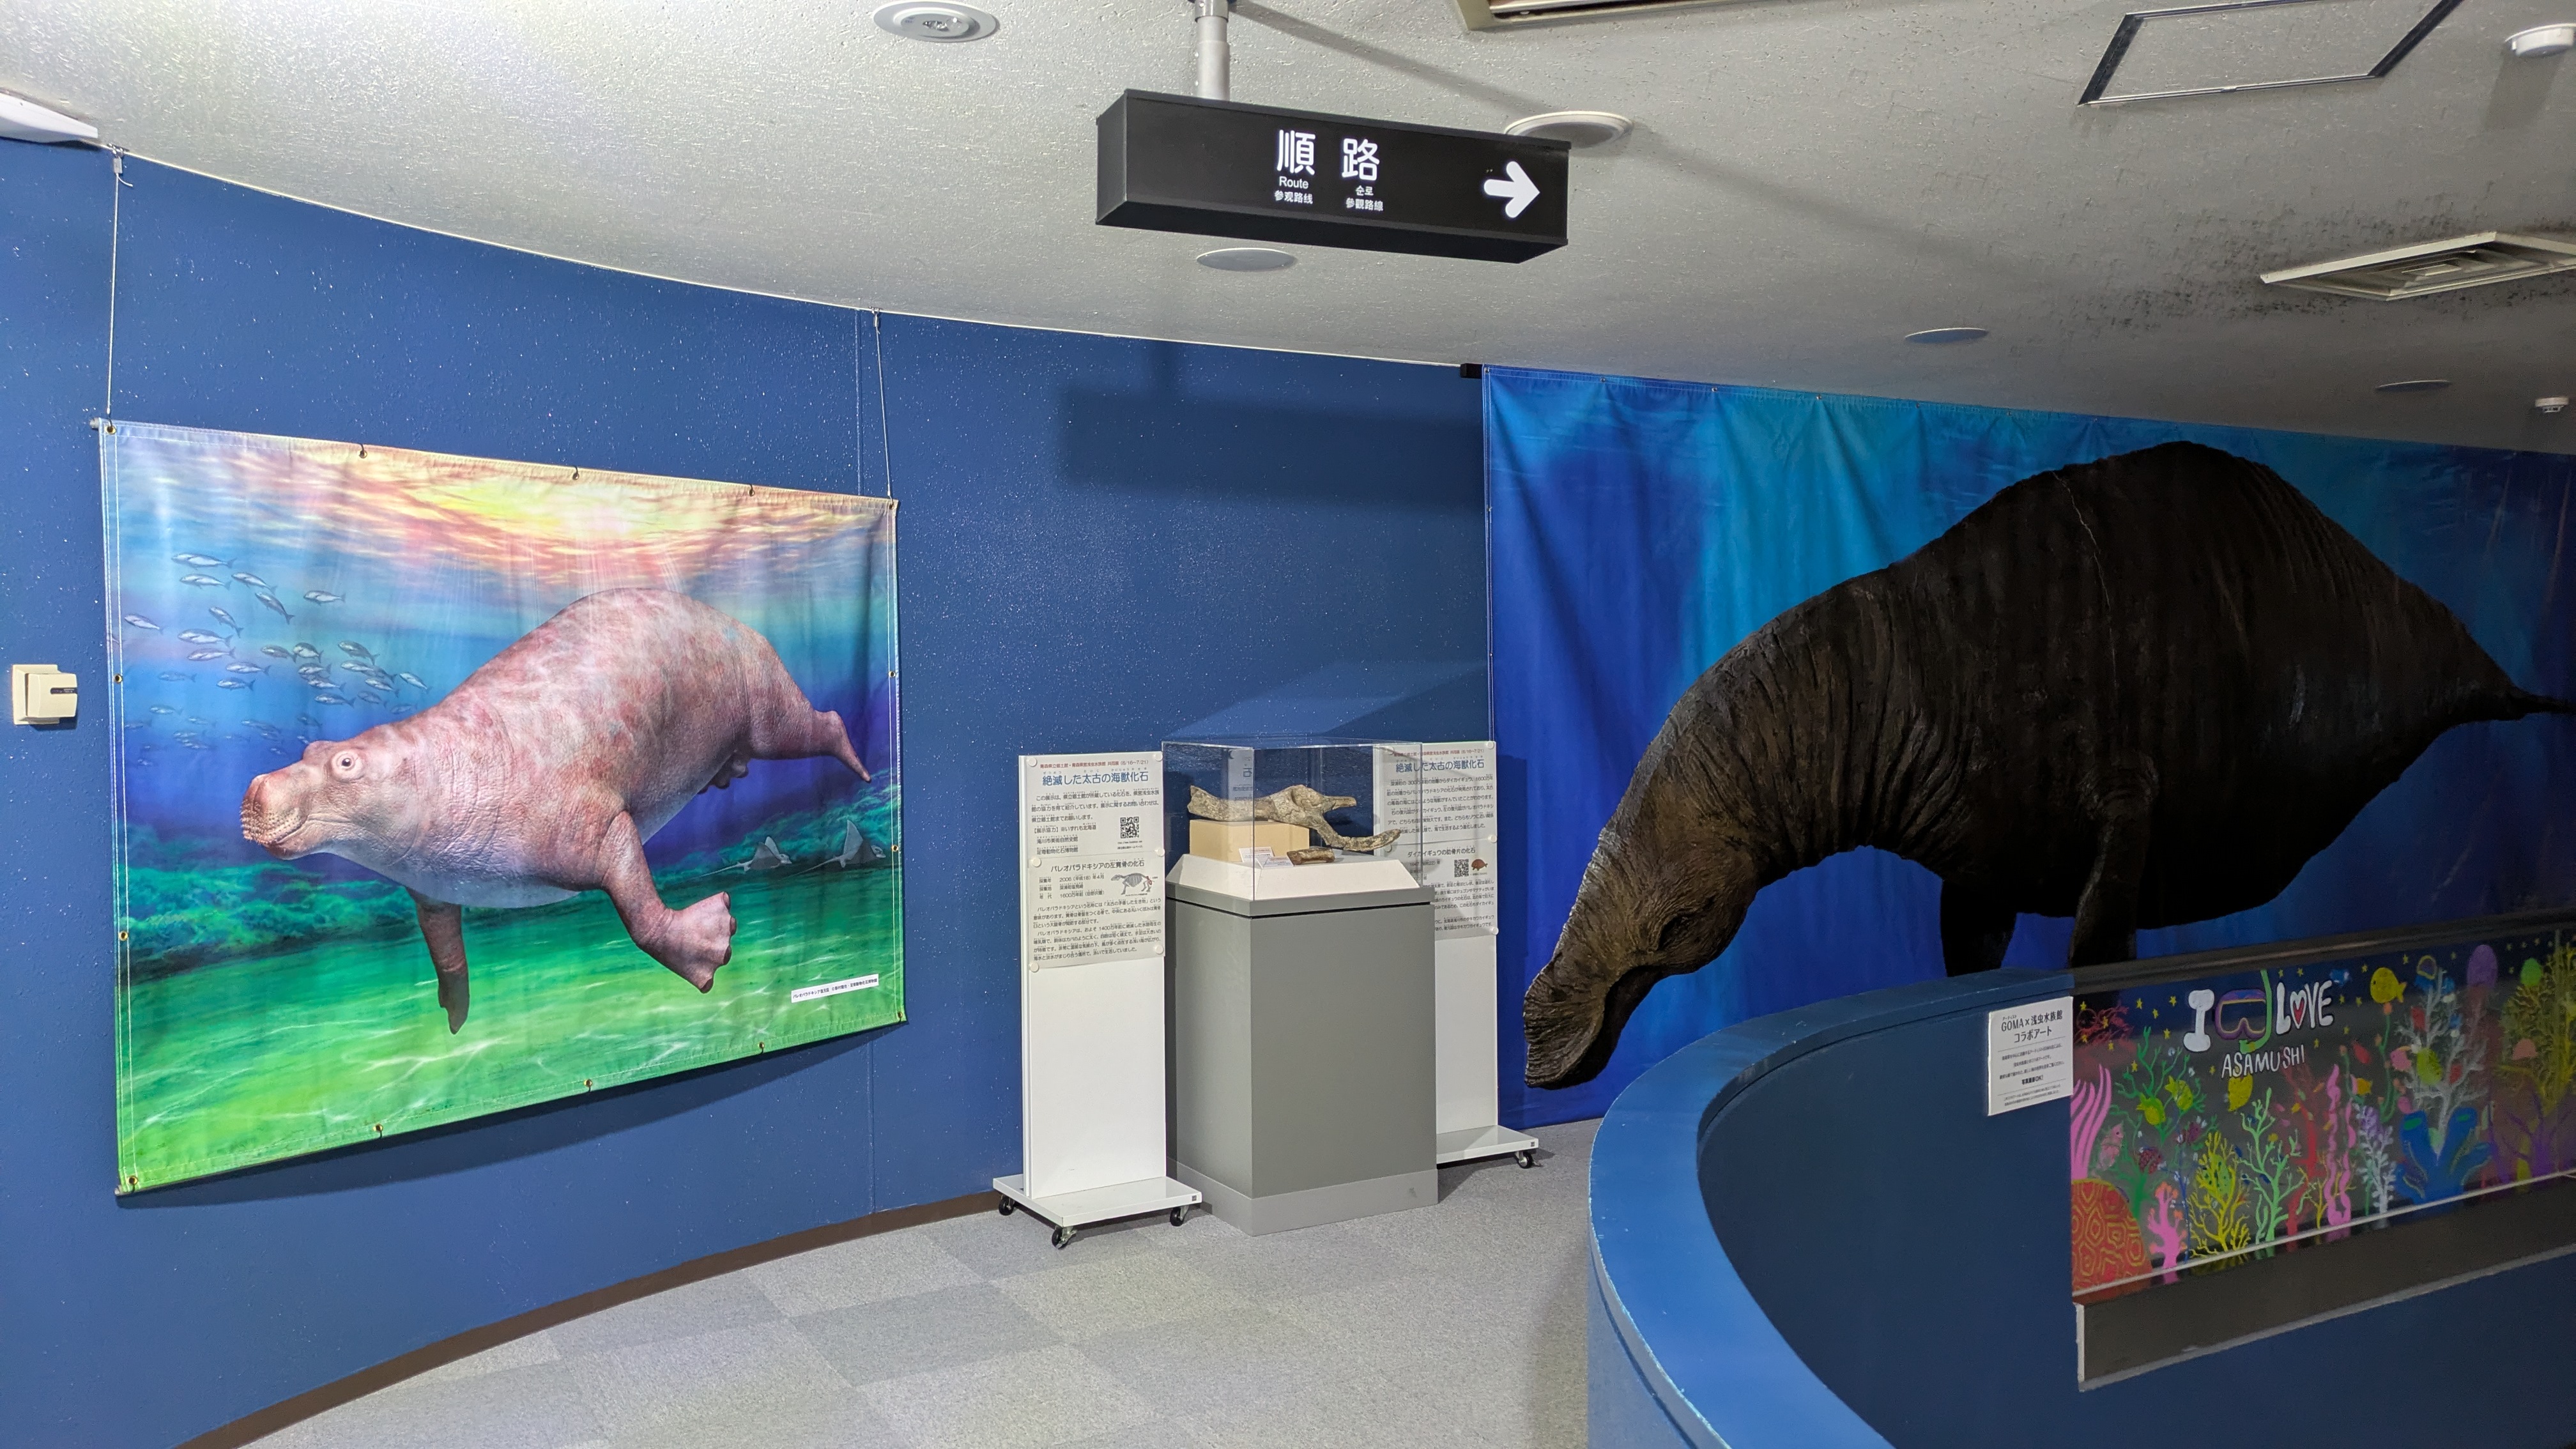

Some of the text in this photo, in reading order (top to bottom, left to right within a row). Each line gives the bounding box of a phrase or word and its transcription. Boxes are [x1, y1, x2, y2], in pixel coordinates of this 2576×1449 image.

[1278, 176, 1309, 189] Route
[1355, 185, 1374, 196] 순로
[1042, 771, 1149, 786] 絶滅した太古の海獣化石
[2182, 979, 2334, 1052] I LOVE
[2014, 1025, 2052, 1043] コラボアート
[2221, 1043, 2306, 1078] ASAMUSHI
